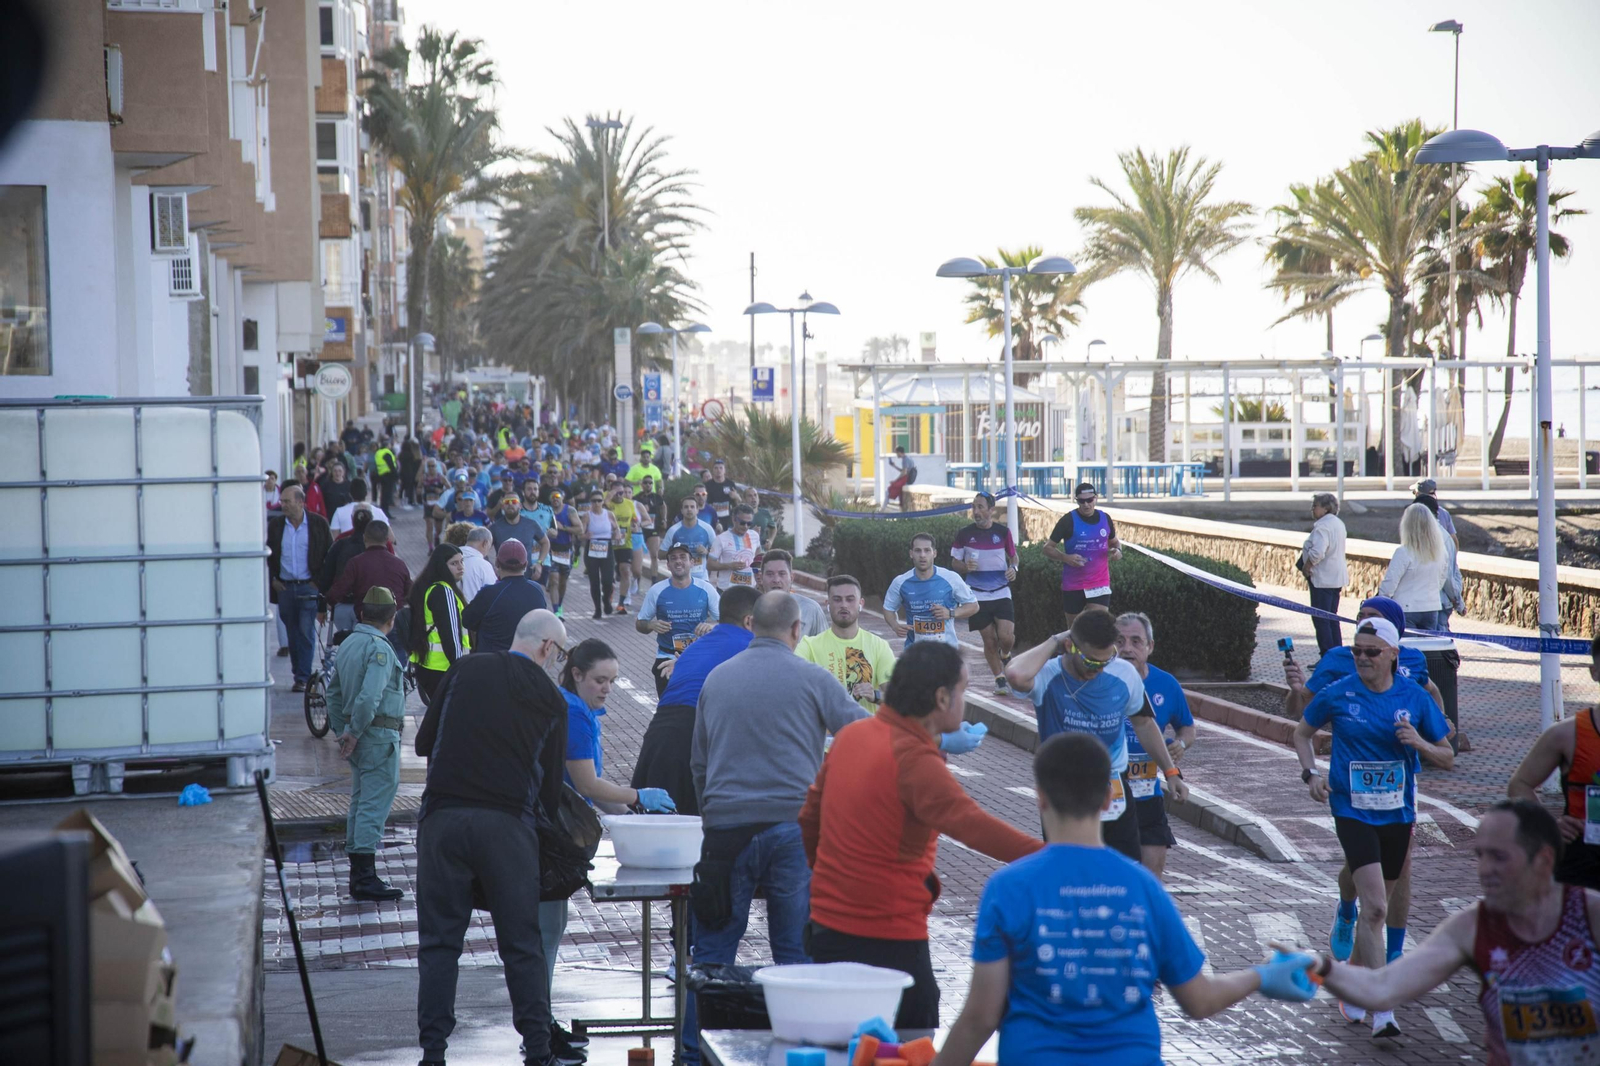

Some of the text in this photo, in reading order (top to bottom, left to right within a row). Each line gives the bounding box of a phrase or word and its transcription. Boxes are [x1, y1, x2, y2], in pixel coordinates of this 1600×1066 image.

[917, 621, 943, 631] 1409
[1100, 717, 1120, 729] 2025
[1127, 763, 1148, 776] 01
[1362, 771, 1396, 787] 974
[1511, 1003, 1586, 1032] 1398
